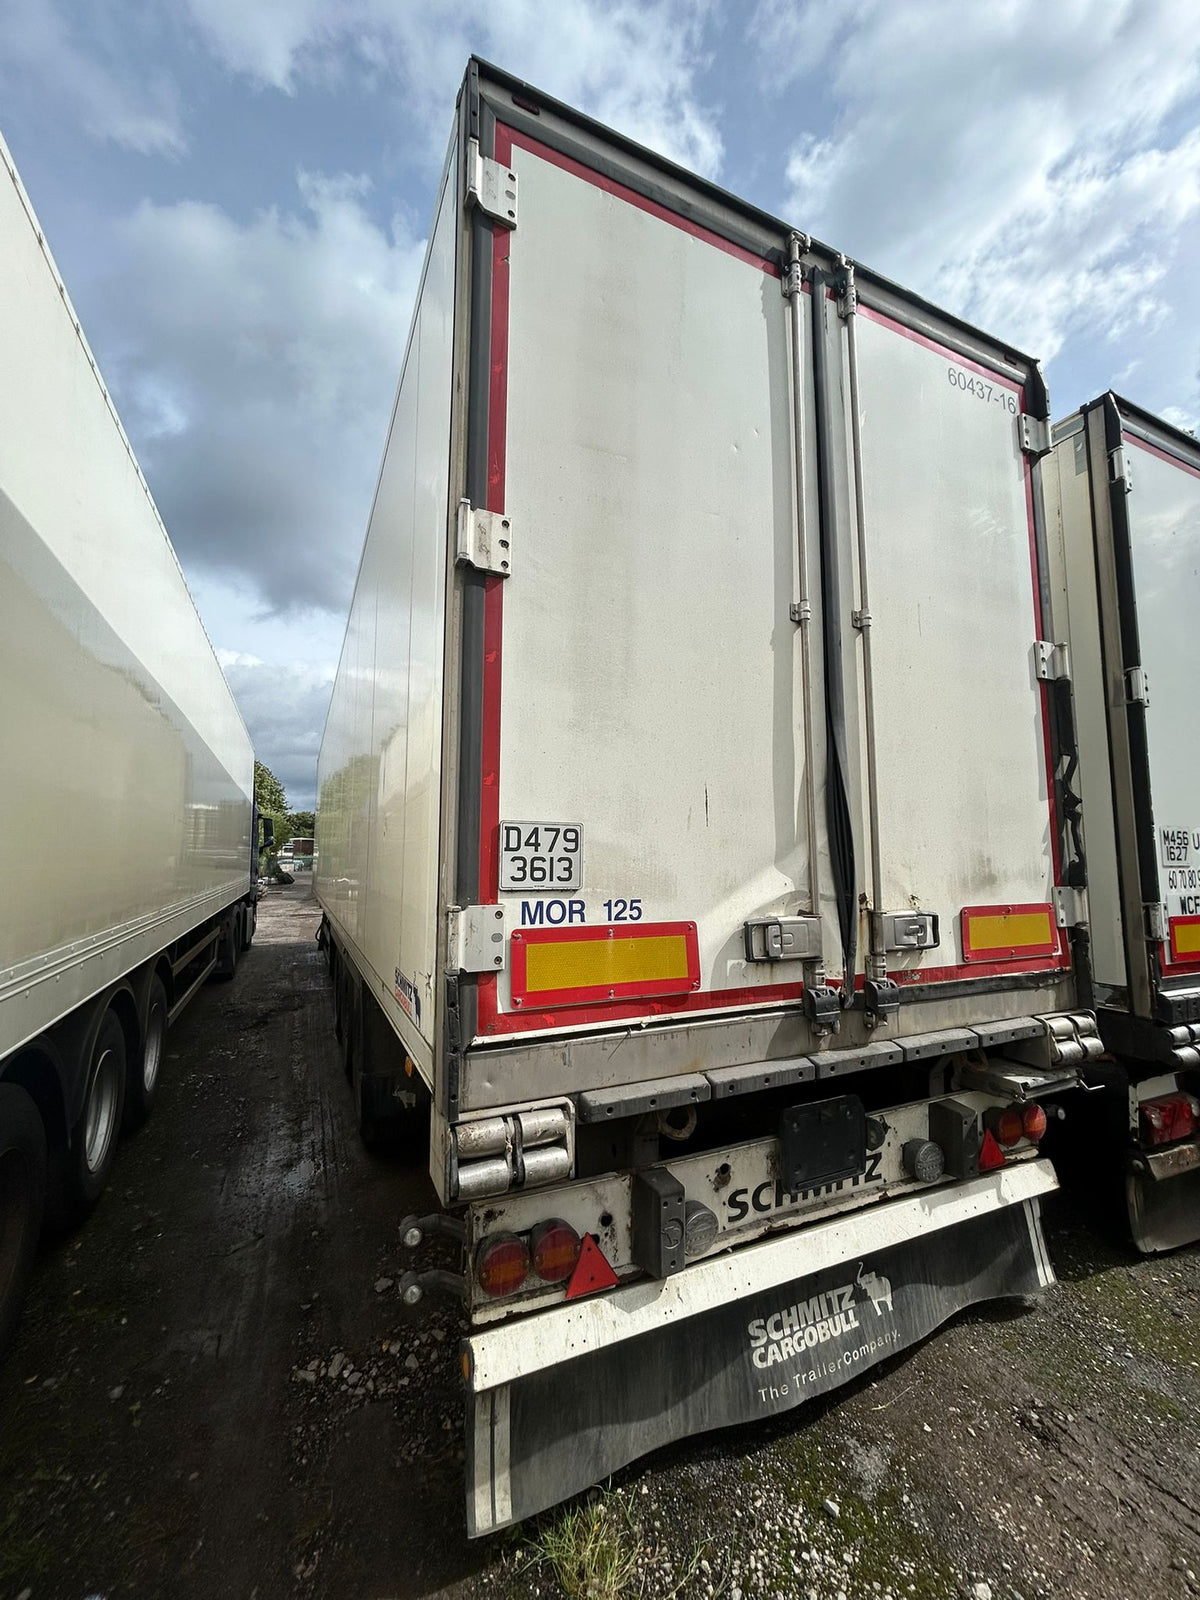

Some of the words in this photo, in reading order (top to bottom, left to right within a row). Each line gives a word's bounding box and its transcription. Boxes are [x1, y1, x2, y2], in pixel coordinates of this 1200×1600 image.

[947, 367, 1017, 414] 60437-16
[504, 826, 579, 853] D479
[1163, 830, 1189, 846] M456
[1166, 846, 1188, 861] 1627
[510, 856, 573, 882] 3613
[521, 899, 586, 925] MOR
[603, 899, 643, 921] 125
[747, 1283, 856, 1347] SCHMITZ
[752, 1309, 860, 1369] CARGOBULL
[758, 1383, 789, 1402] The
